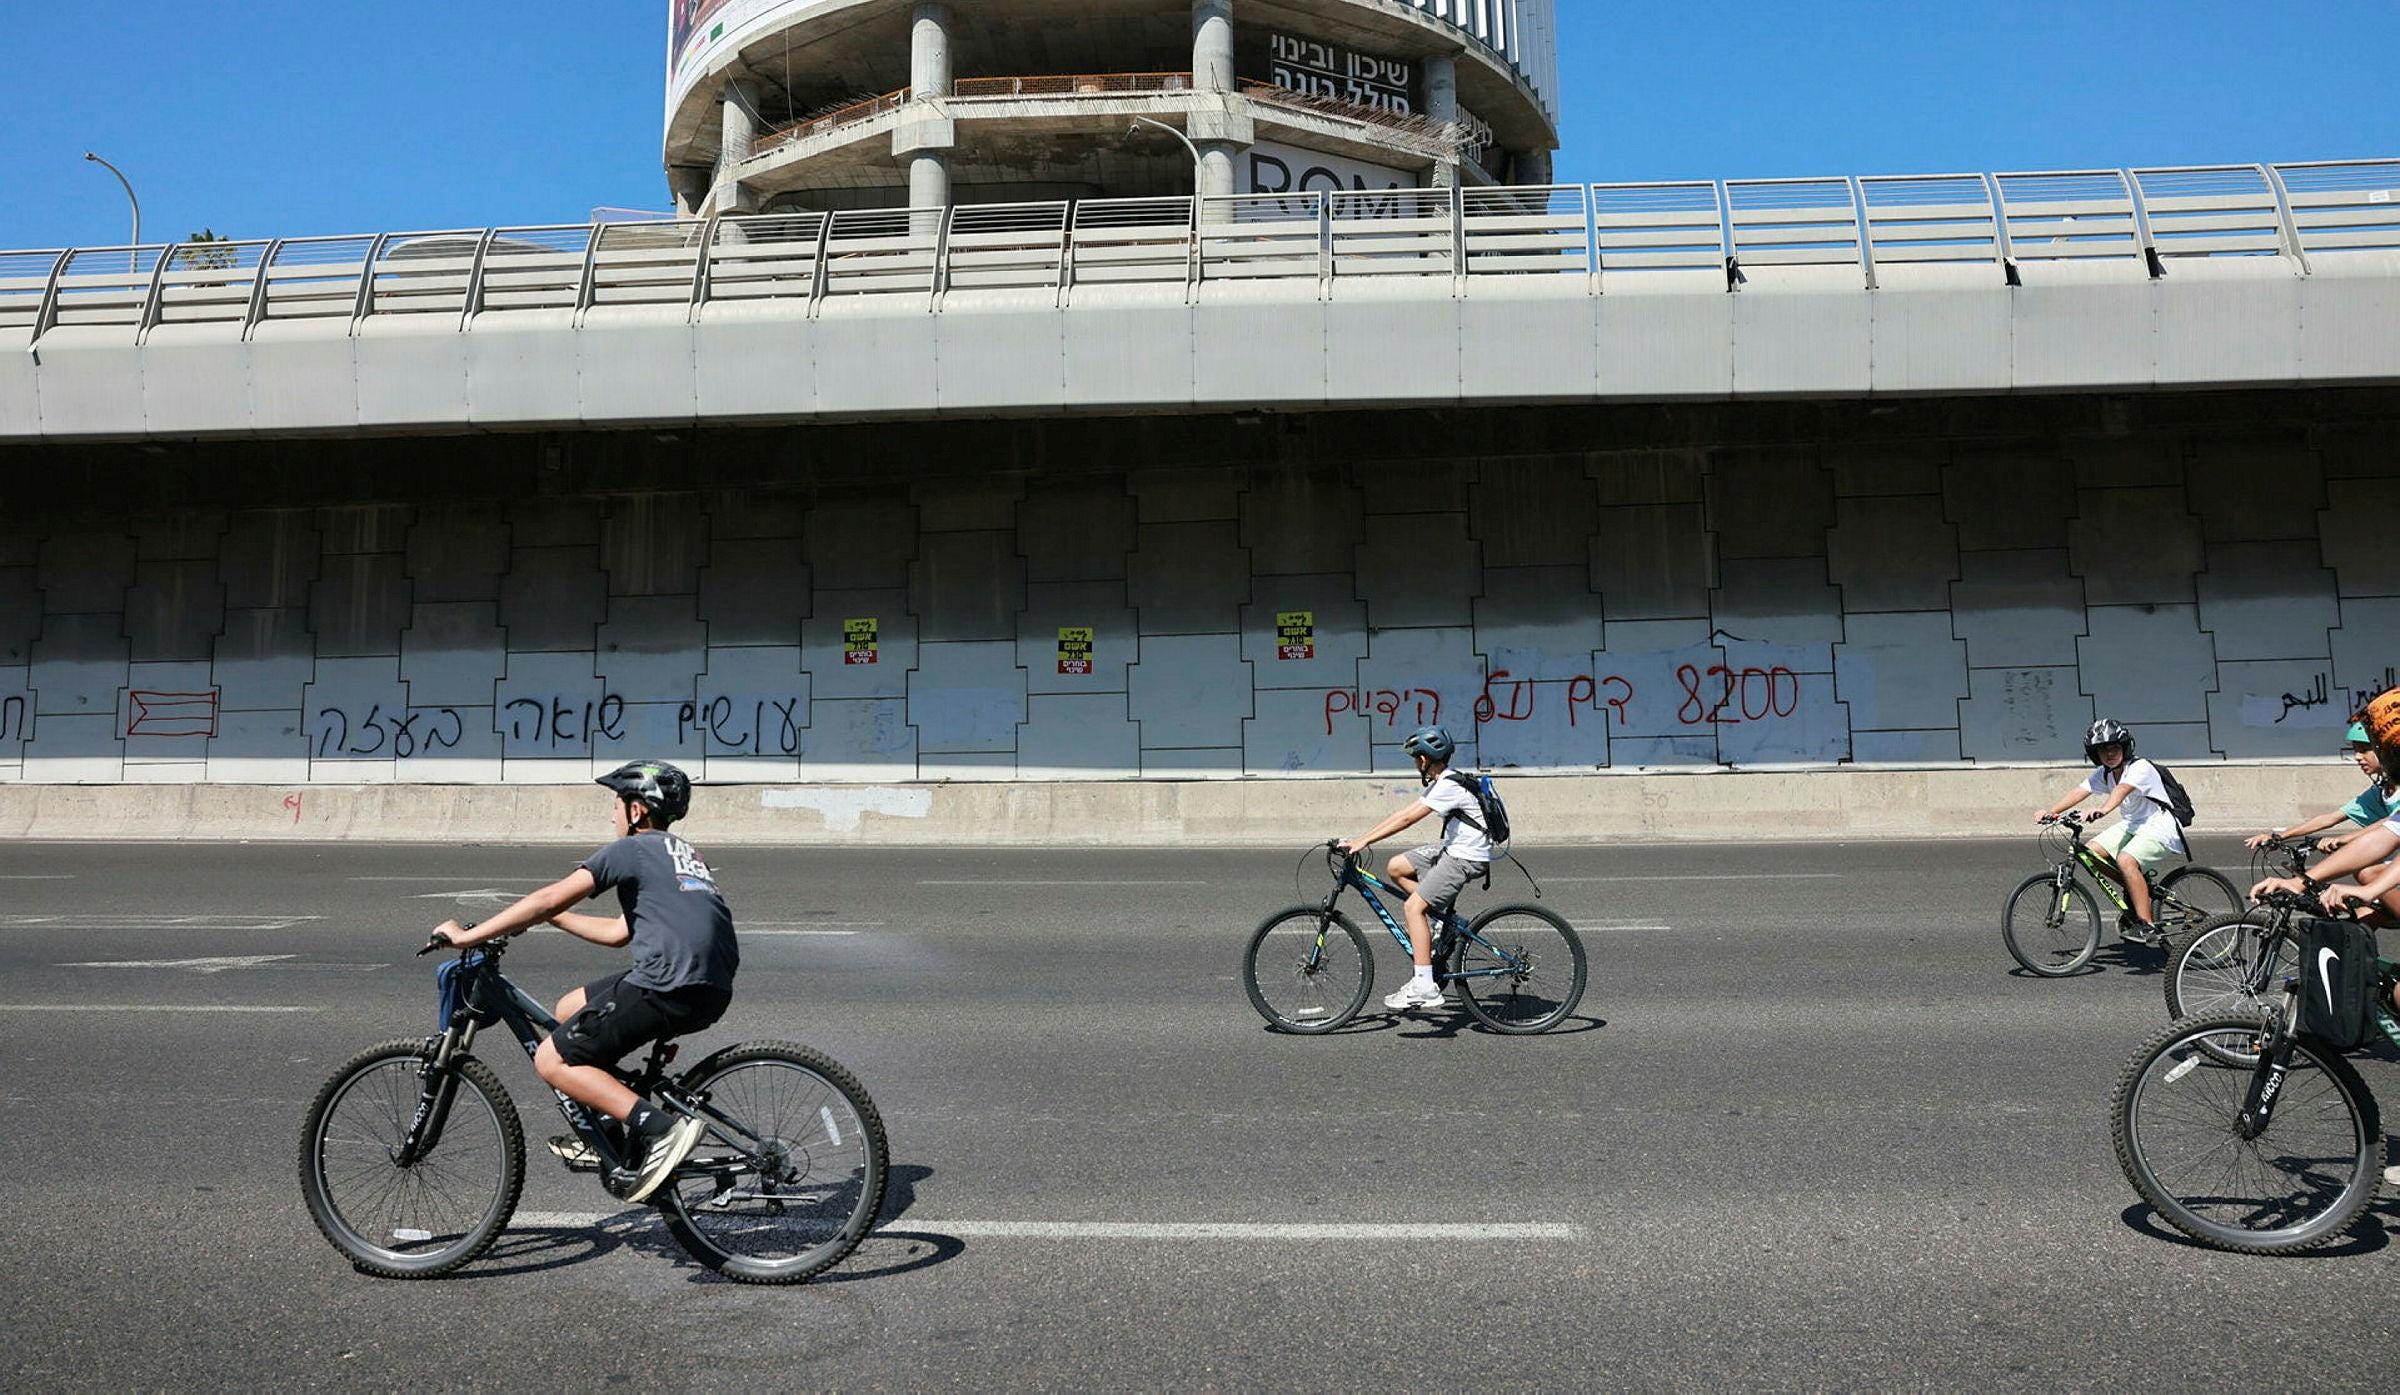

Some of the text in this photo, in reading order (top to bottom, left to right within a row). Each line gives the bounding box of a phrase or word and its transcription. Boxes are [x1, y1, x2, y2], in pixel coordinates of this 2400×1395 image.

[1271, 34, 1409, 86] שיכון ובינוי
[1568, 675, 1634, 727] דם
[1676, 664, 1798, 724] 8200
[504, 695, 625, 749] שואה
[678, 696, 798, 754] עושים
